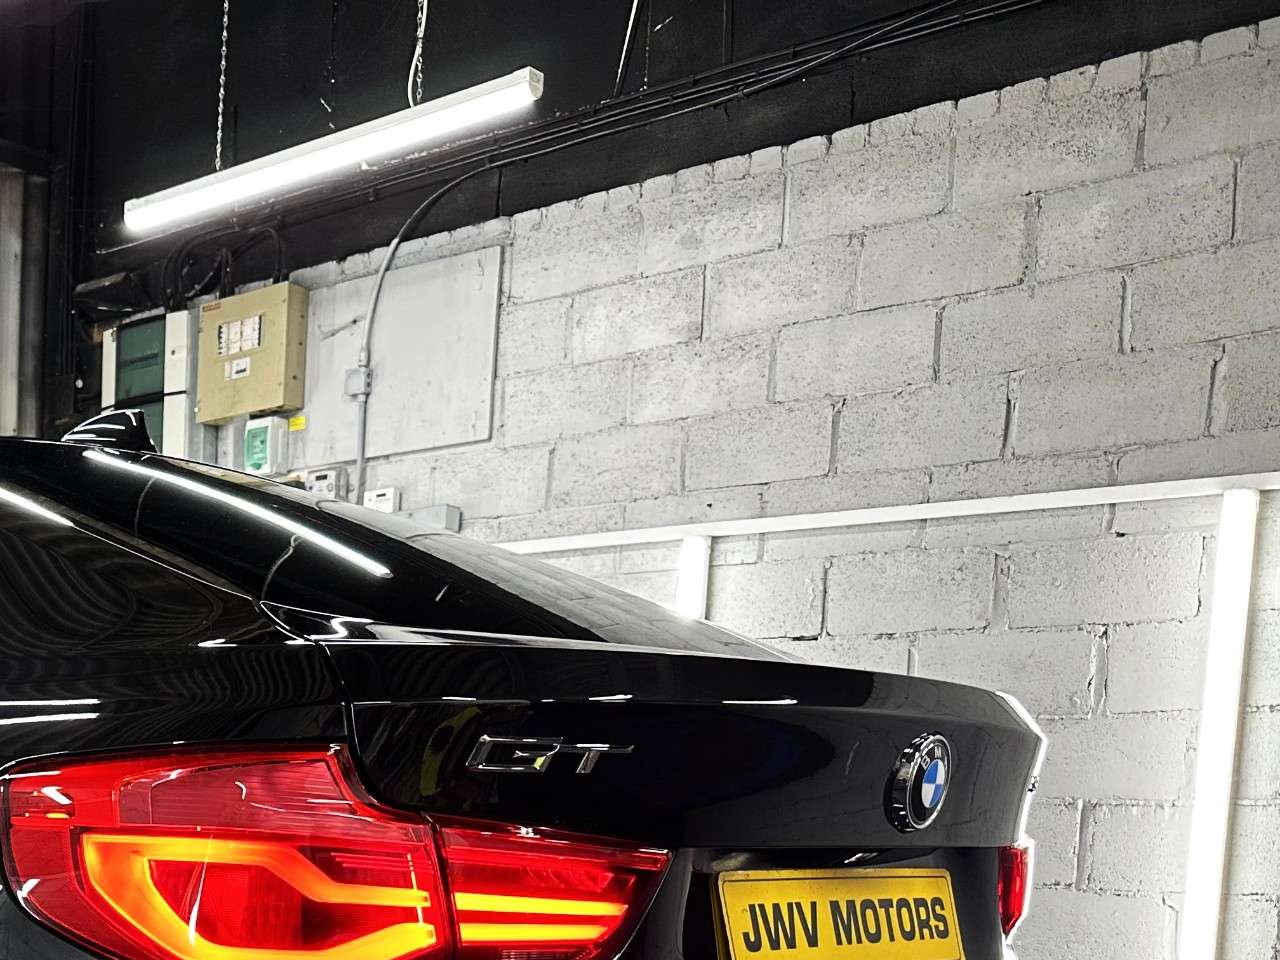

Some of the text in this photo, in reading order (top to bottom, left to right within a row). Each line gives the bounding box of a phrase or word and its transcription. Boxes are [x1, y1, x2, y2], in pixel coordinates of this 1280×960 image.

[465, 734, 635, 774] GT
[742, 897, 949, 953] JWV MOTORS
